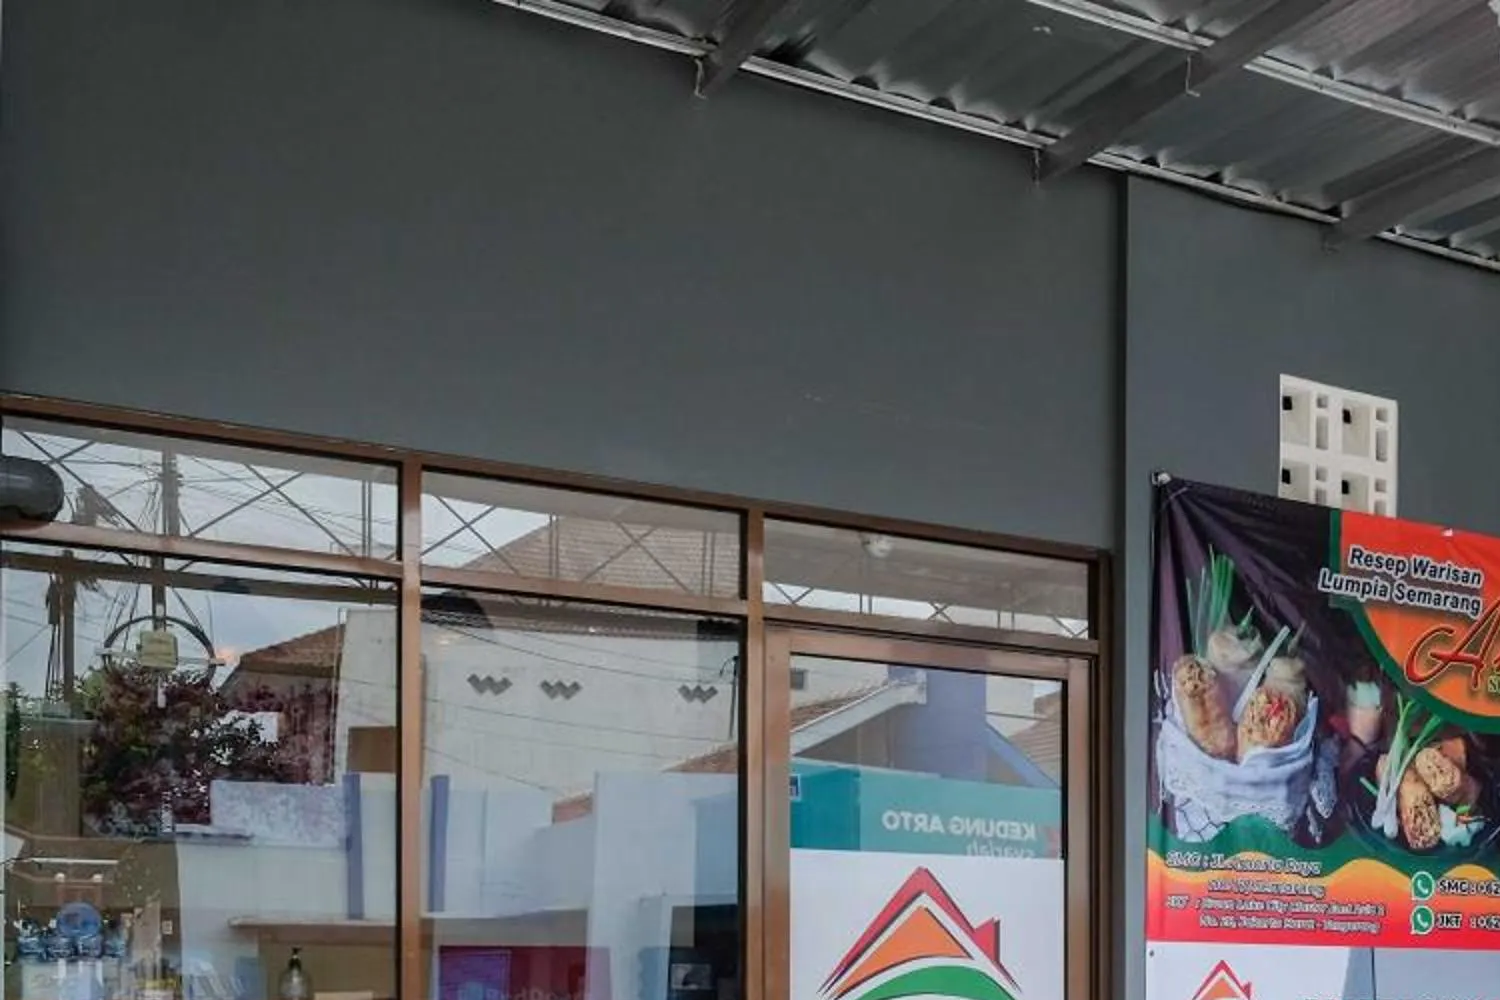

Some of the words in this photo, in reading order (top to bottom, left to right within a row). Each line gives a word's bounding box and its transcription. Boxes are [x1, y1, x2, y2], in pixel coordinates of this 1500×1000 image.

[1349, 547, 1408, 577] Resep
[1411, 556, 1483, 588] Warisan
[1319, 569, 1389, 602] Lumpia
[1393, 583, 1483, 619] Semarang
[1438, 913, 1463, 928] JKT
